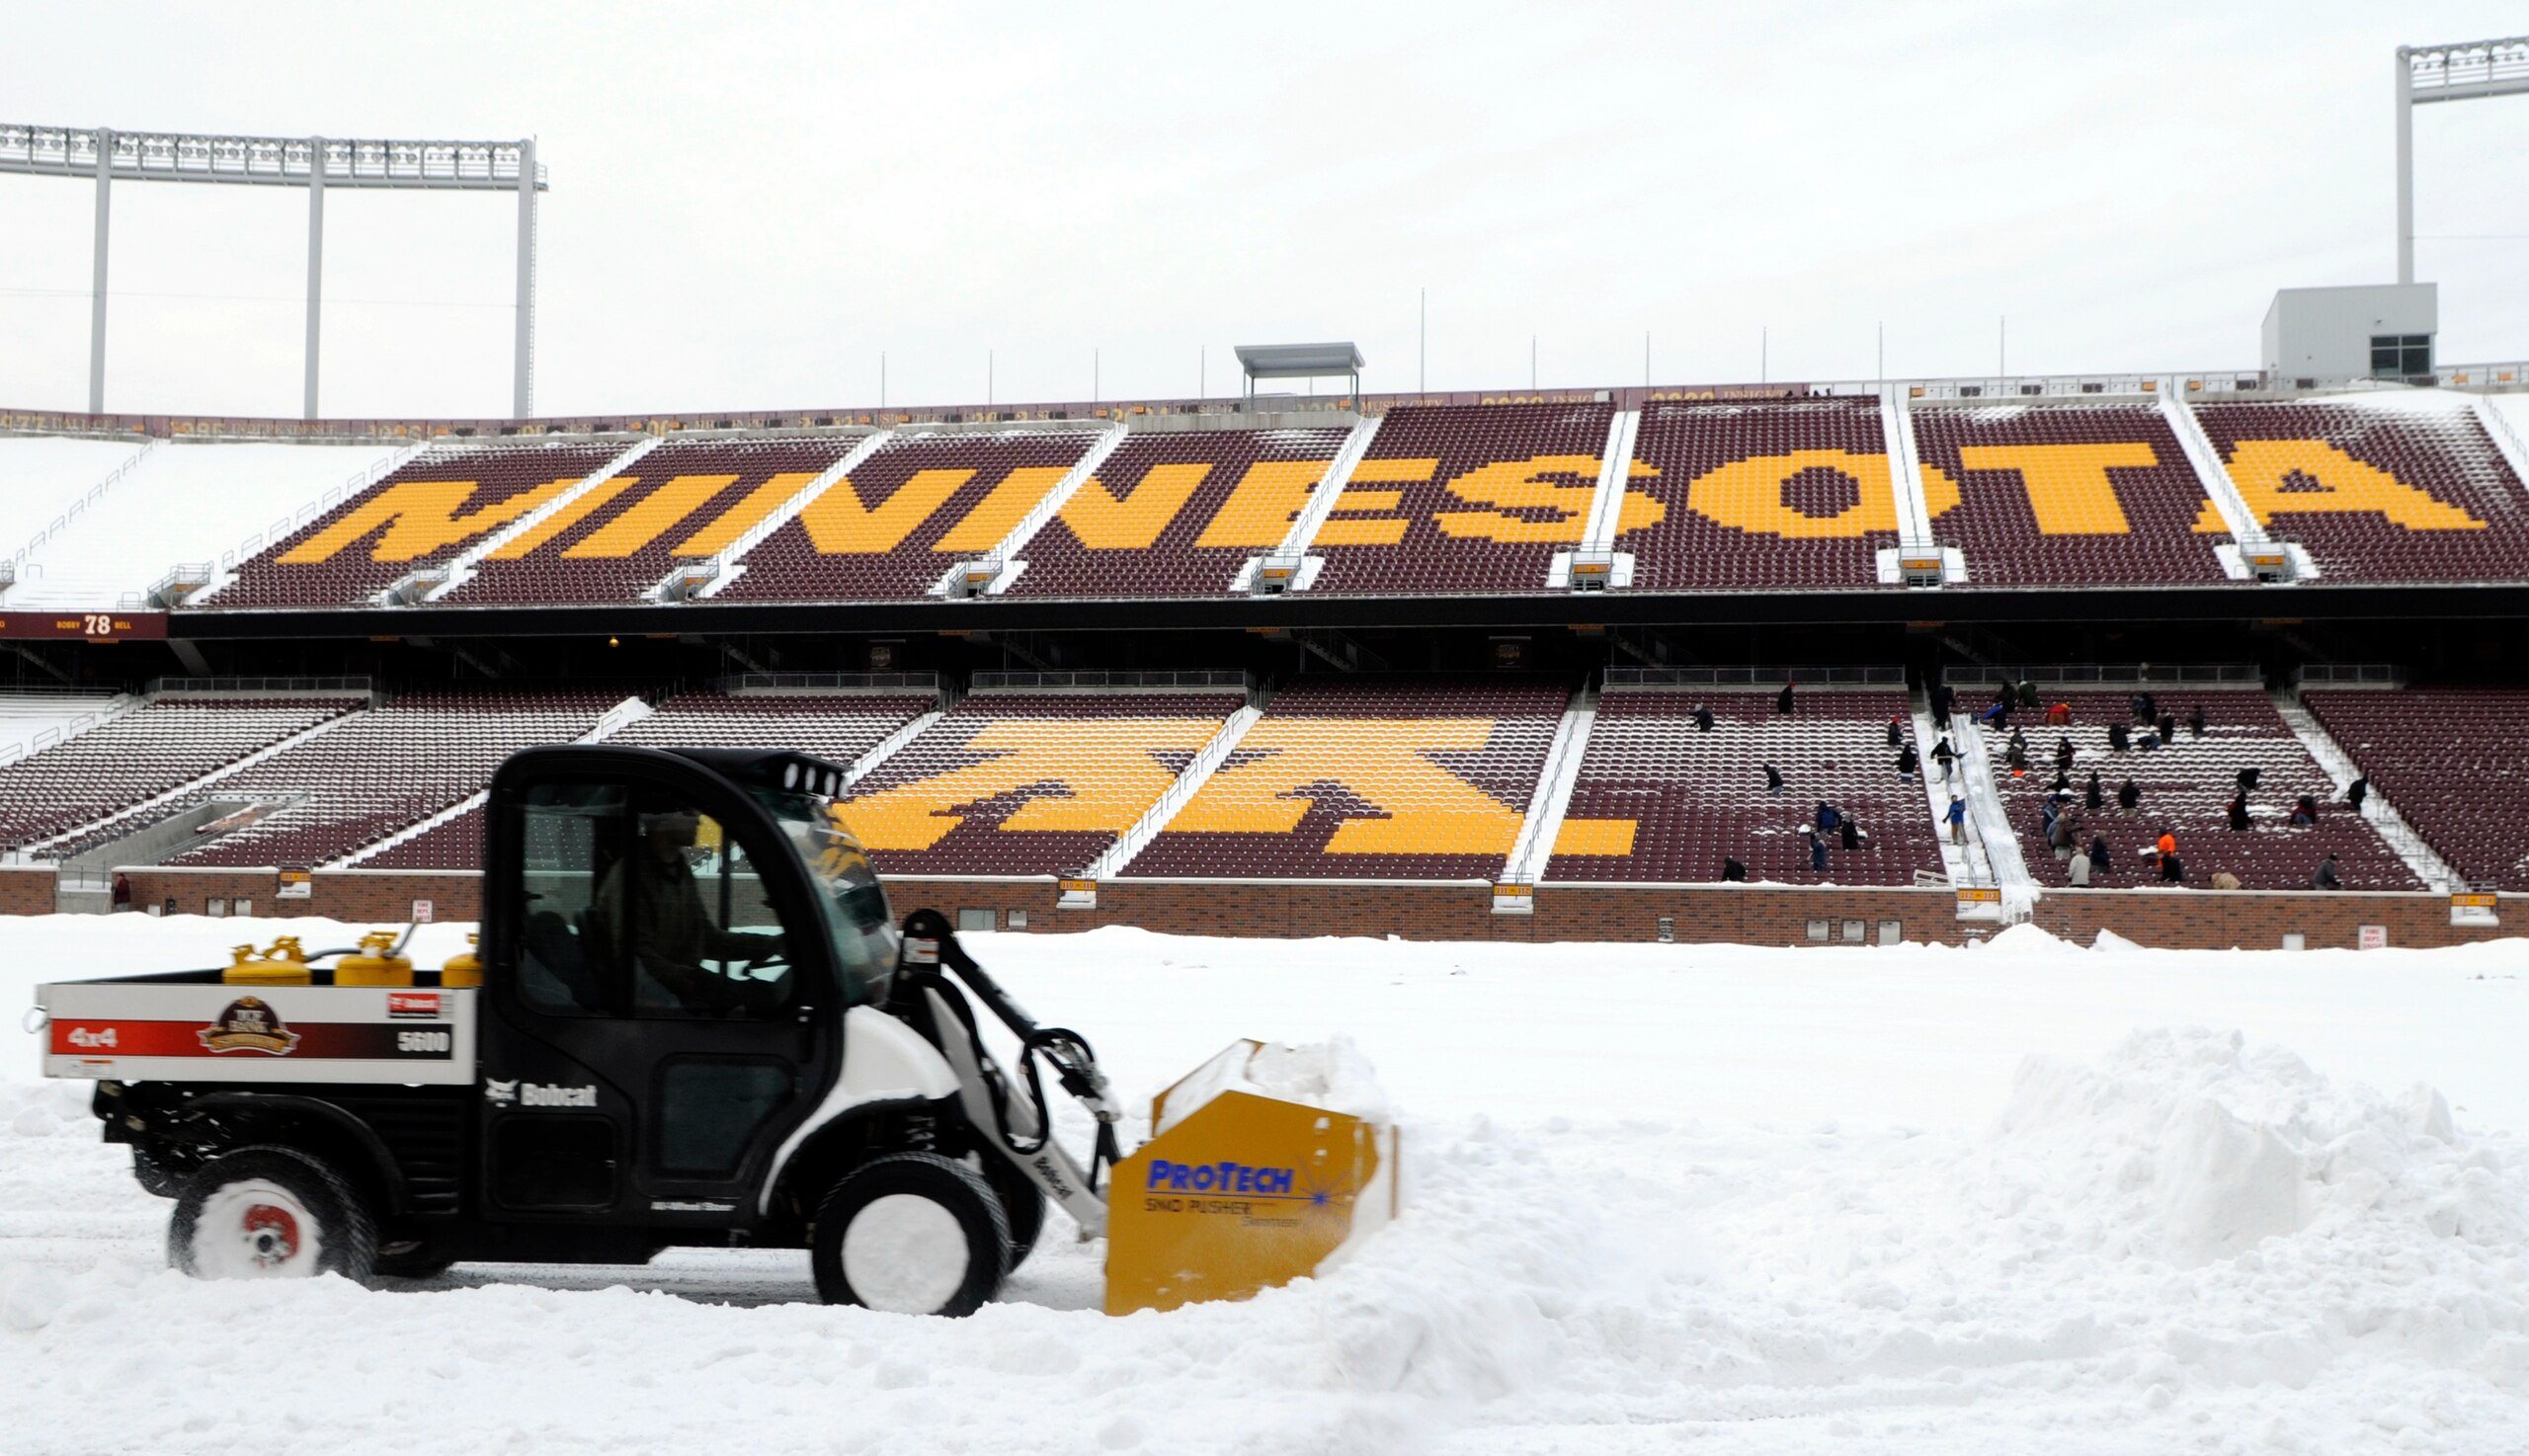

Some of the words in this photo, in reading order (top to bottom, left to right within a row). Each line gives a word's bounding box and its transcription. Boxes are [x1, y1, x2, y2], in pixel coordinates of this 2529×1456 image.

[277, 438, 2487, 564] MINNESOTA
[56, 620, 81, 629] BOBBY
[84, 614, 111, 635] 78
[114, 620, 131, 630] BELL
[67, 1026, 119, 1048] 4x4
[397, 1031, 449, 1052] 5600
[520, 1083, 598, 1107] Bobcat
[1187, 1200, 1252, 1216] PUSHER
